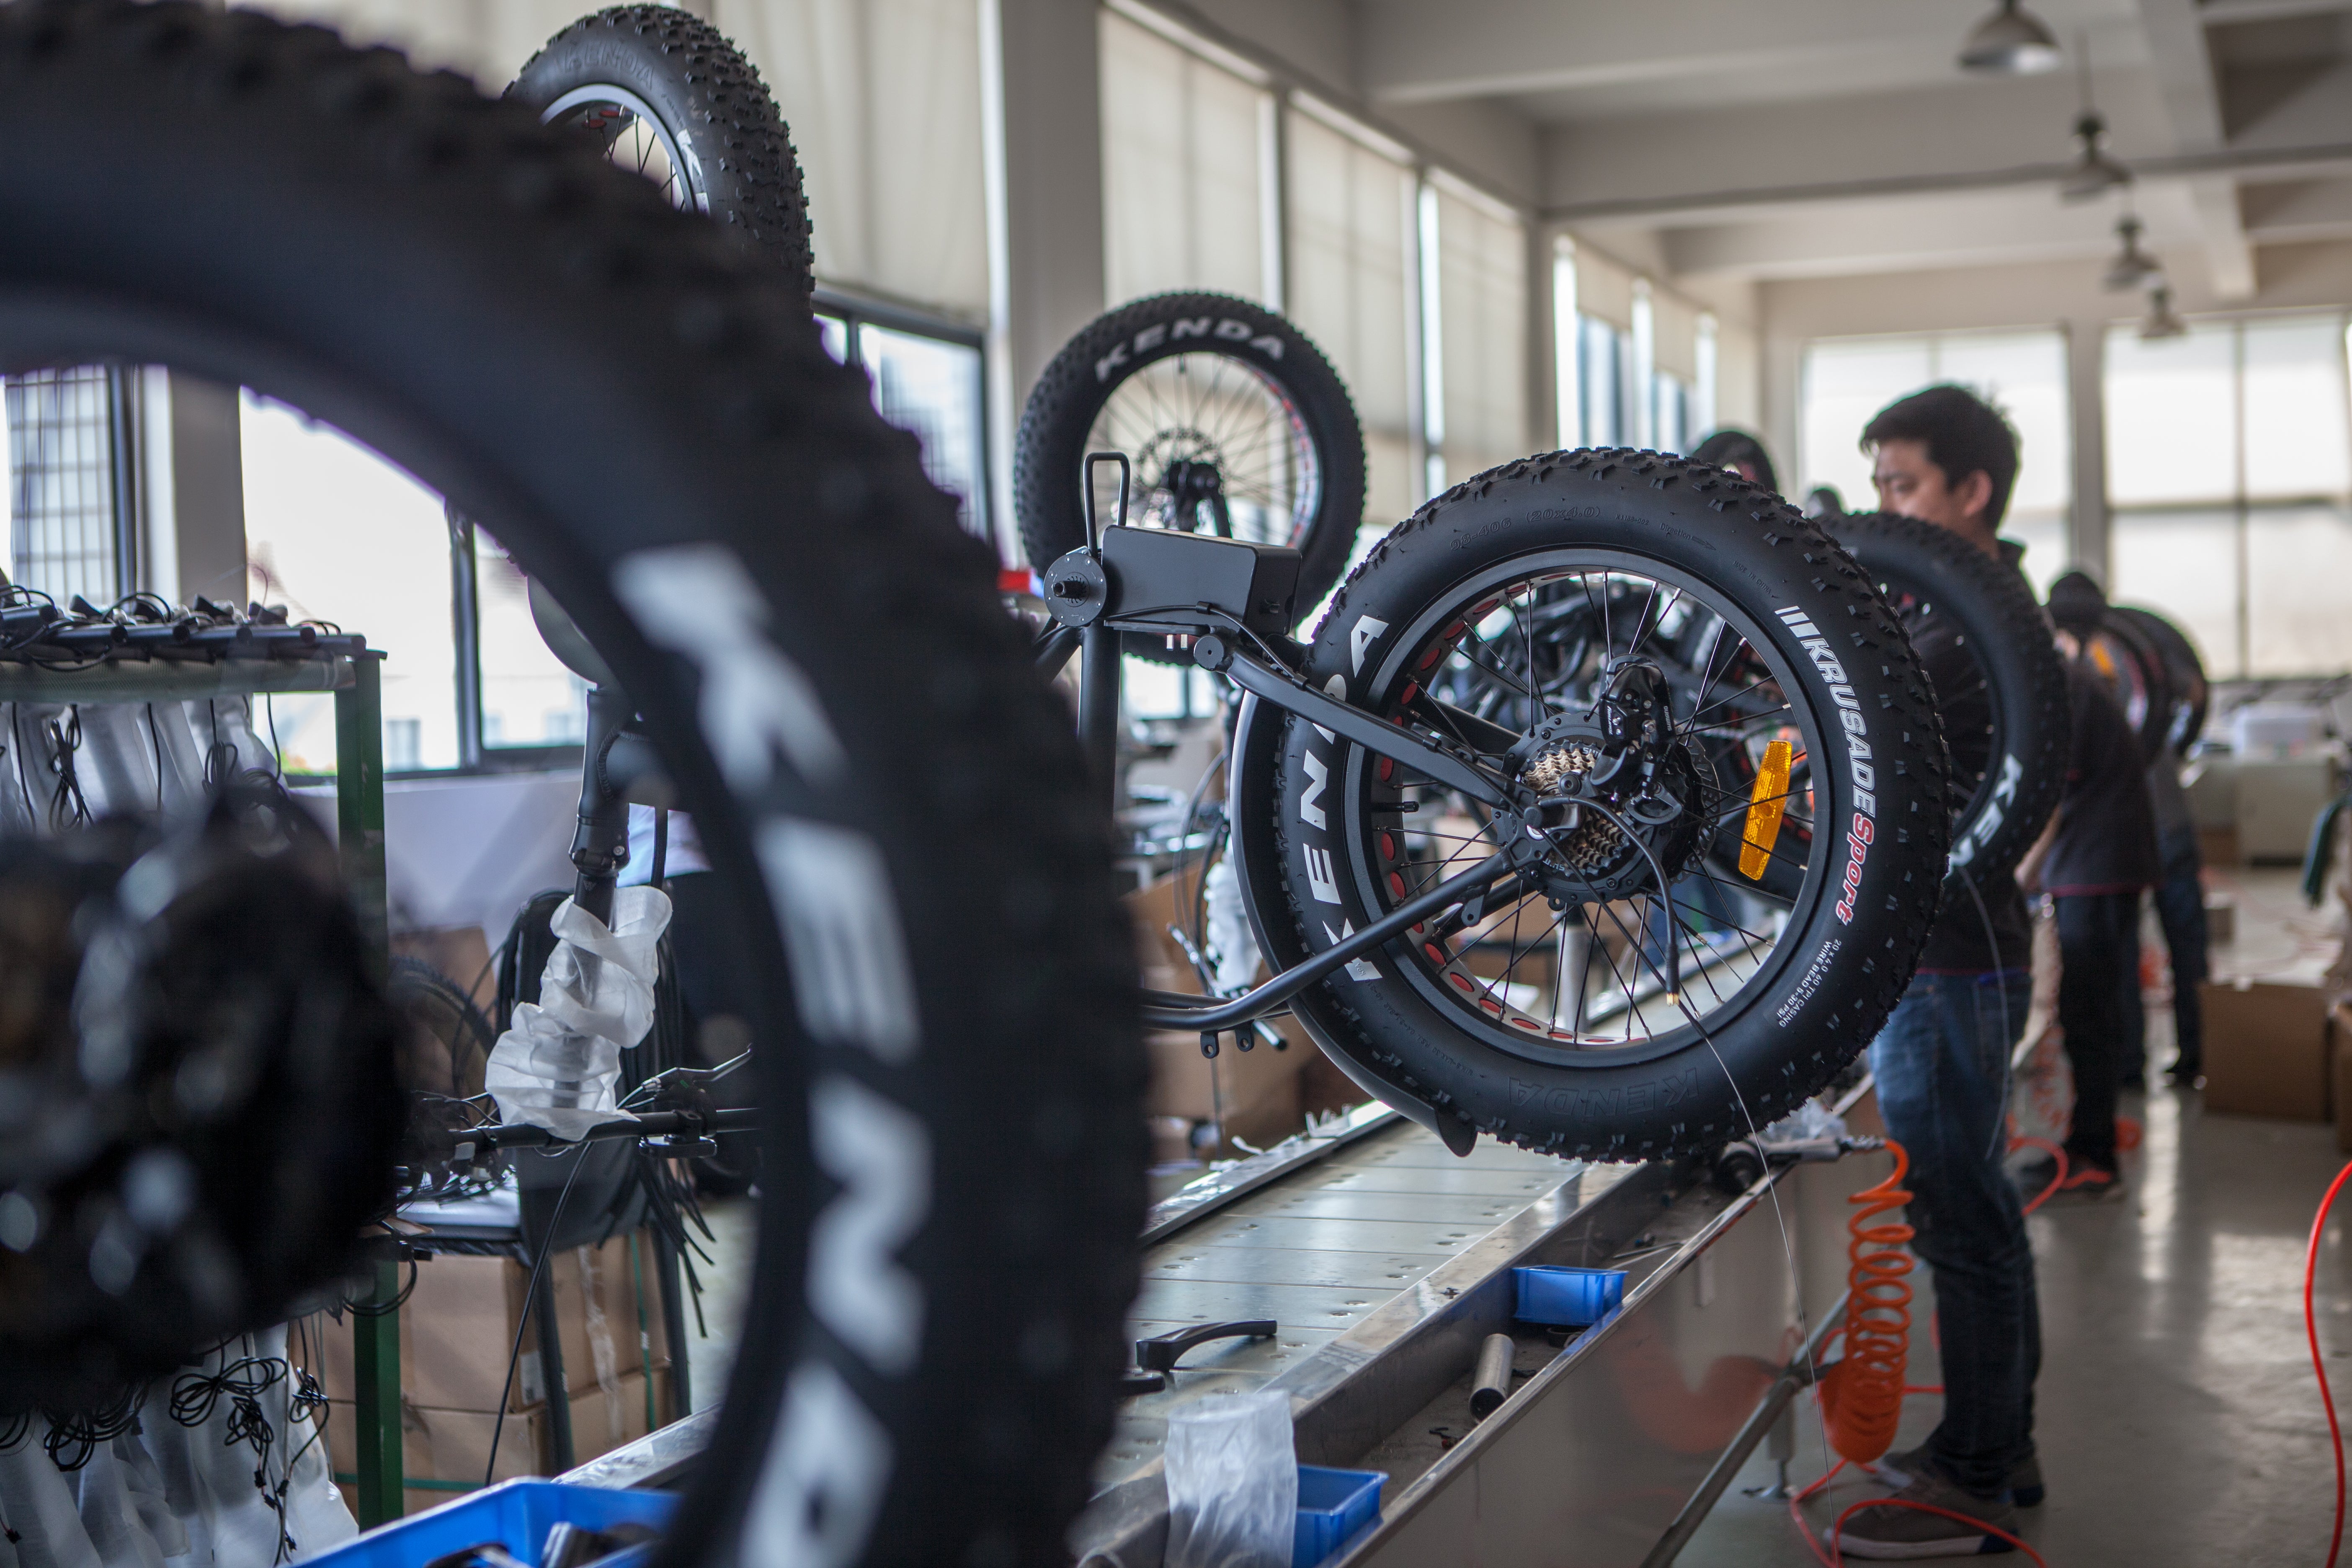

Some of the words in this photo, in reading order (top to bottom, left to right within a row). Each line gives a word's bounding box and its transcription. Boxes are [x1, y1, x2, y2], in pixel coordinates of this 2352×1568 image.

[1094, 317, 1284, 384] KENDA
[1450, 518, 1511, 550] 98-406
[1659, 523, 1691, 540] Direction
[1733, 561, 1747, 573] MADE
[1756, 579, 1772, 594] CHINA
[1663, 706, 1672, 731] SHIMANO
[1801, 637, 1876, 818] KRUSADE
[1836, 812, 1875, 925] Sport
[1816, 941, 1832, 965] WIRE
[1832, 939, 1841, 951] 20
[1355, 962, 1366, 977] KPA
[1802, 964, 1819, 988] BEAD
[1821, 958, 1831, 972] 4.0
[1813, 974, 1822, 986] 60
[1787, 987, 1804, 1006] 5-30
[1802, 986, 1816, 1000] TPI
[1777, 1004, 1790, 1019] PSI
[1779, 999, 1805, 1027] CASING
[1509, 1068, 1699, 1117] KENDA
